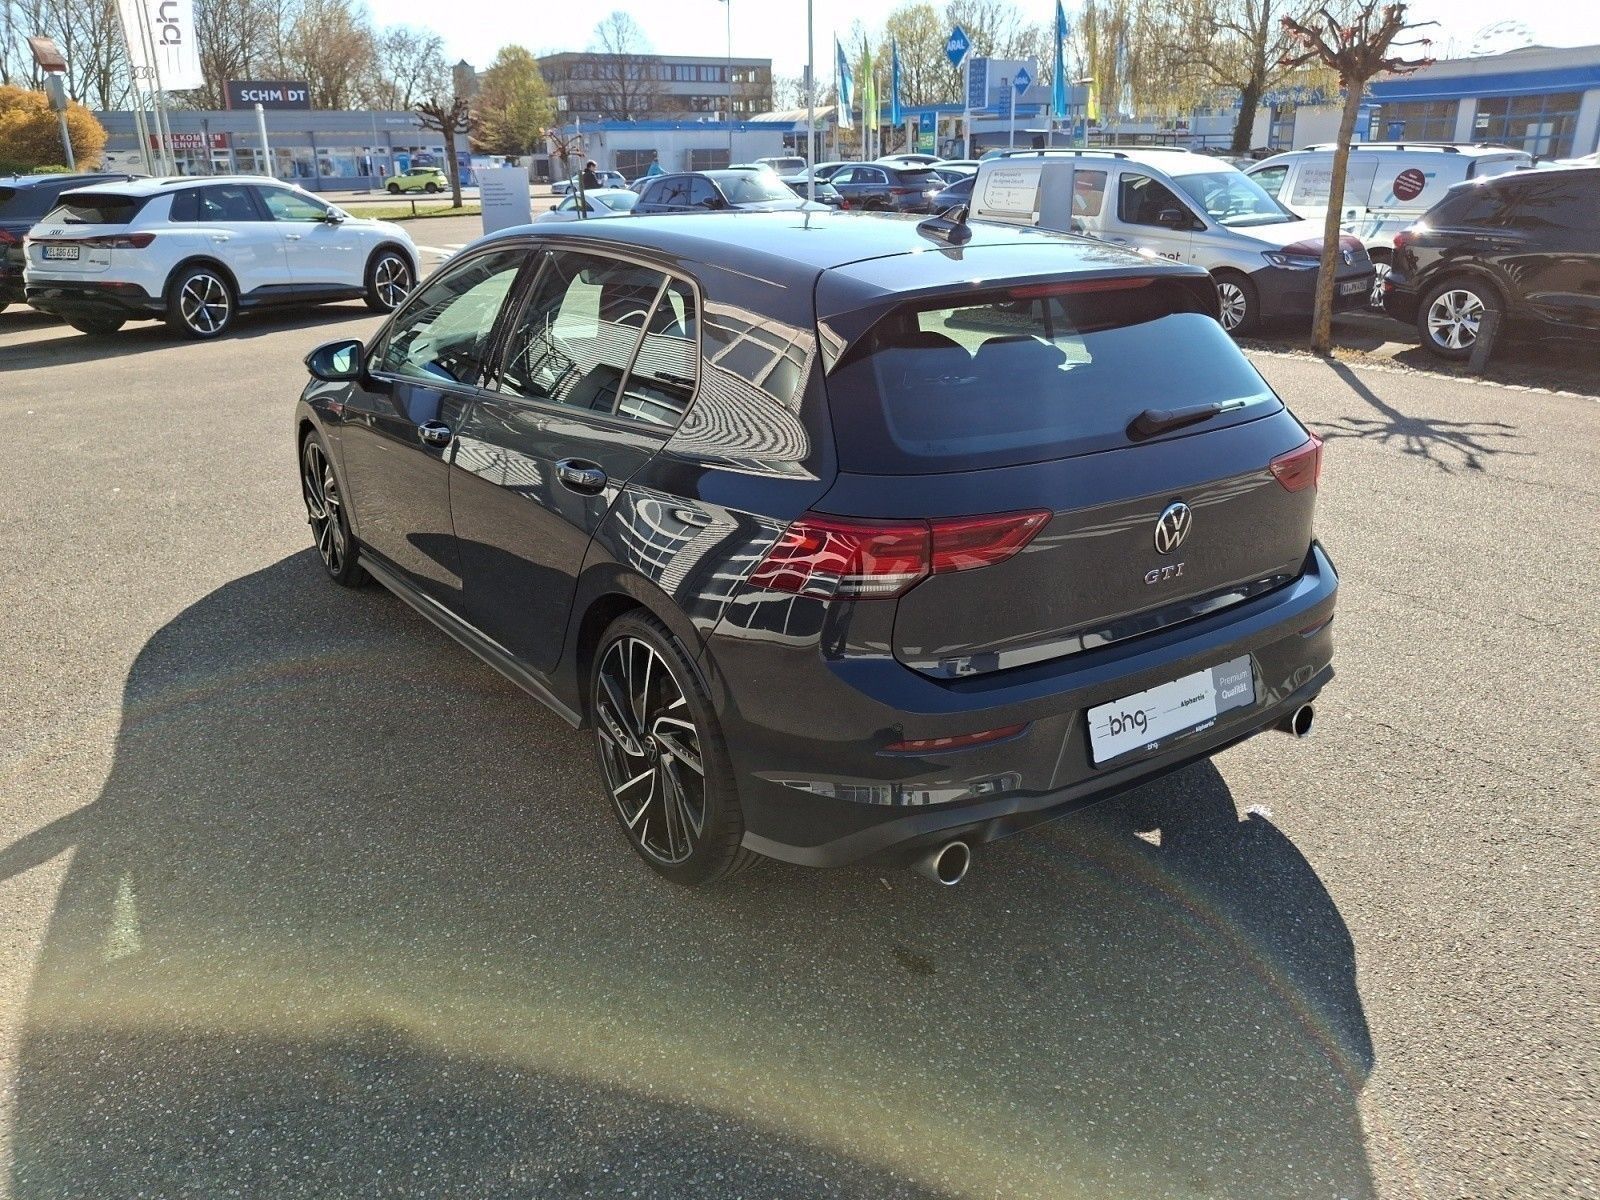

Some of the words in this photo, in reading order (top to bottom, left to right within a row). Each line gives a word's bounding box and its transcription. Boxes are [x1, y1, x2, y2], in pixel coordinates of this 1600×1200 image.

[946, 39, 965, 52] ARAL
[1144, 562, 1185, 585] GTI
[1219, 669, 1249, 687] Premium
[1221, 682, 1248, 700] Qualität
[1109, 709, 1148, 736] bhg
